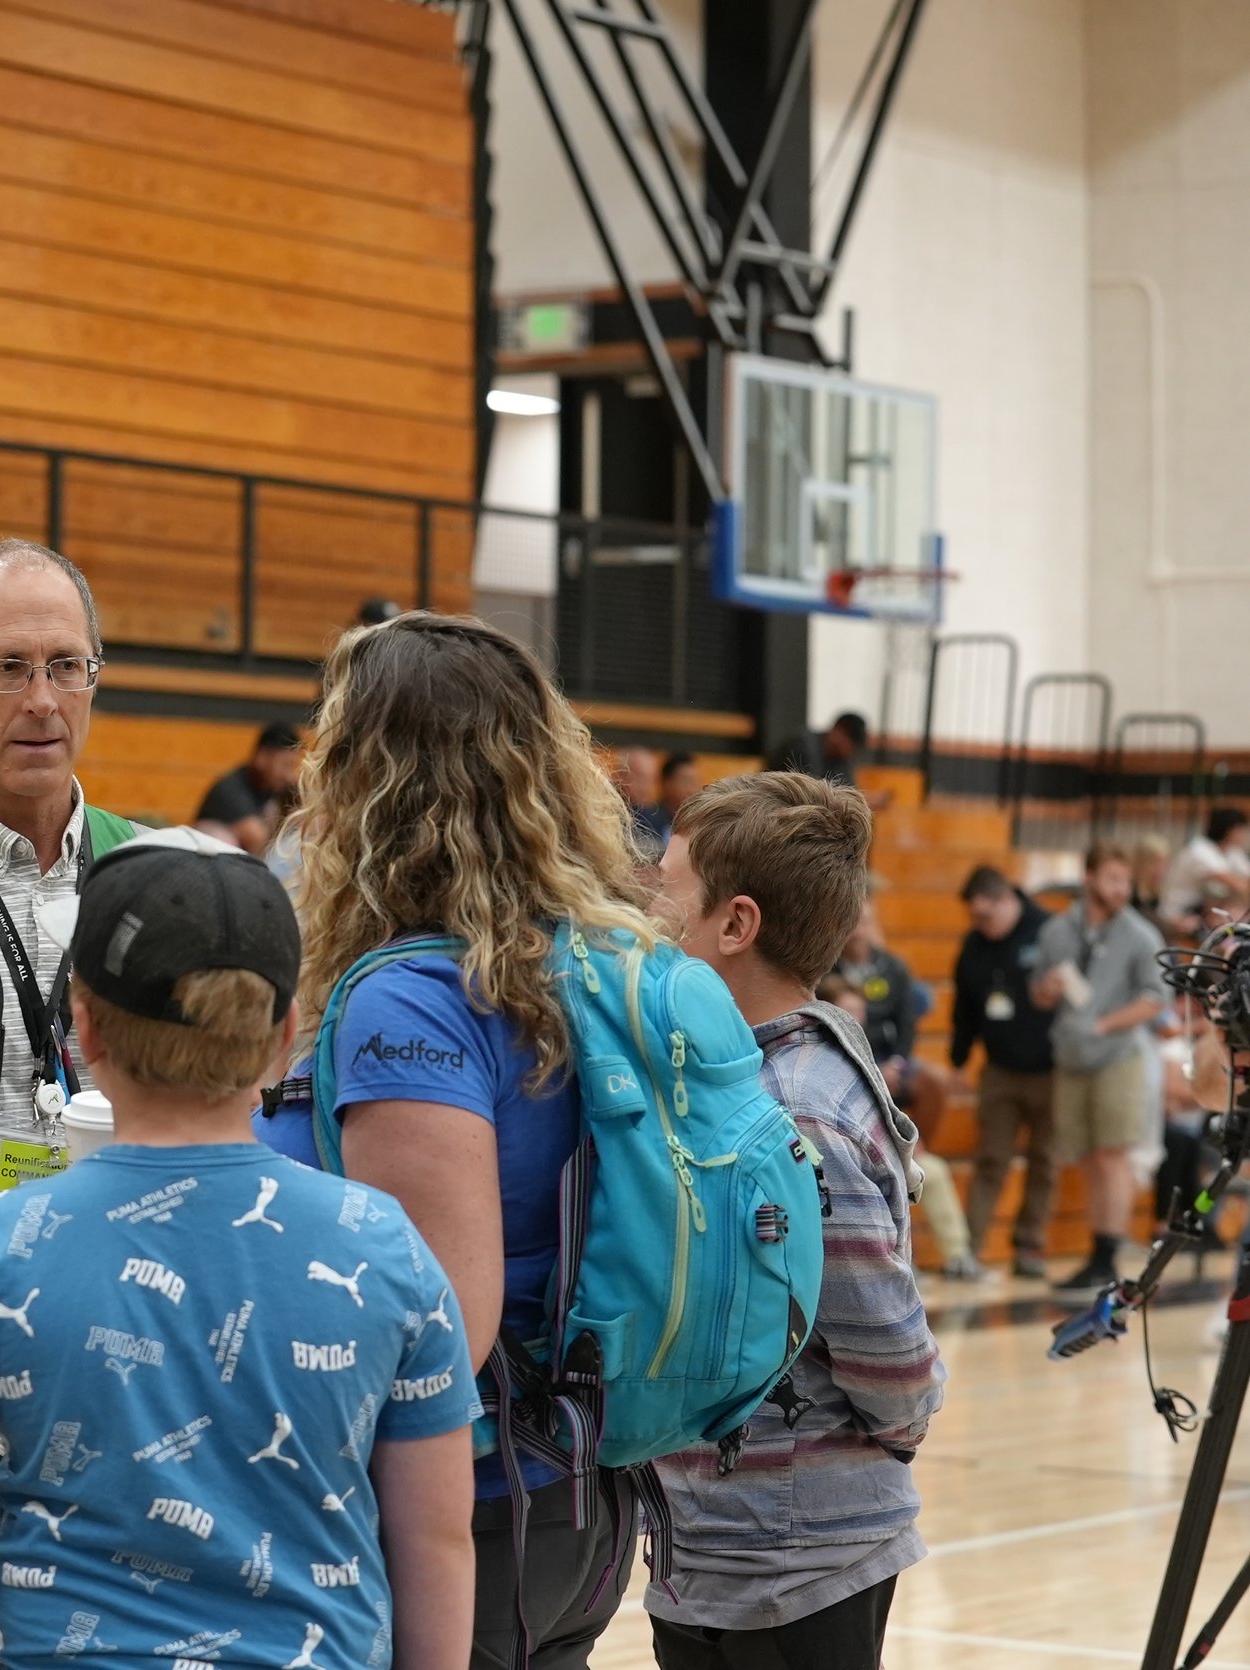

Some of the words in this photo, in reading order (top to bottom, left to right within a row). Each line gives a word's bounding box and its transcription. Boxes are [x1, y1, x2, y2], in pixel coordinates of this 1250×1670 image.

[16, 963, 29, 982] ALL
[351, 1031, 465, 1069] Medford
[105, 1201, 142, 1222] PUMA
[139, 1176, 198, 1207] ATHLETICS
[6, 1193, 53, 1260] PUMA
[119, 1257, 186, 1305] PUMA
[235, 1299, 255, 1331] PUMA
[84, 1325, 165, 1367] PUMA
[220, 1329, 245, 1384] ATHLETICS
[291, 1340, 357, 1372] PUMA
[390, 1365, 454, 1402] PUMA
[39, 1420, 82, 1488] PUMA
[132, 1441, 163, 1463] PUMA
[161, 1415, 213, 1447] ATHLETICS
[146, 1497, 215, 1540] PUMA
[2, 1561, 58, 1589] PUMA
[55, 1610, 100, 1656] UMA
